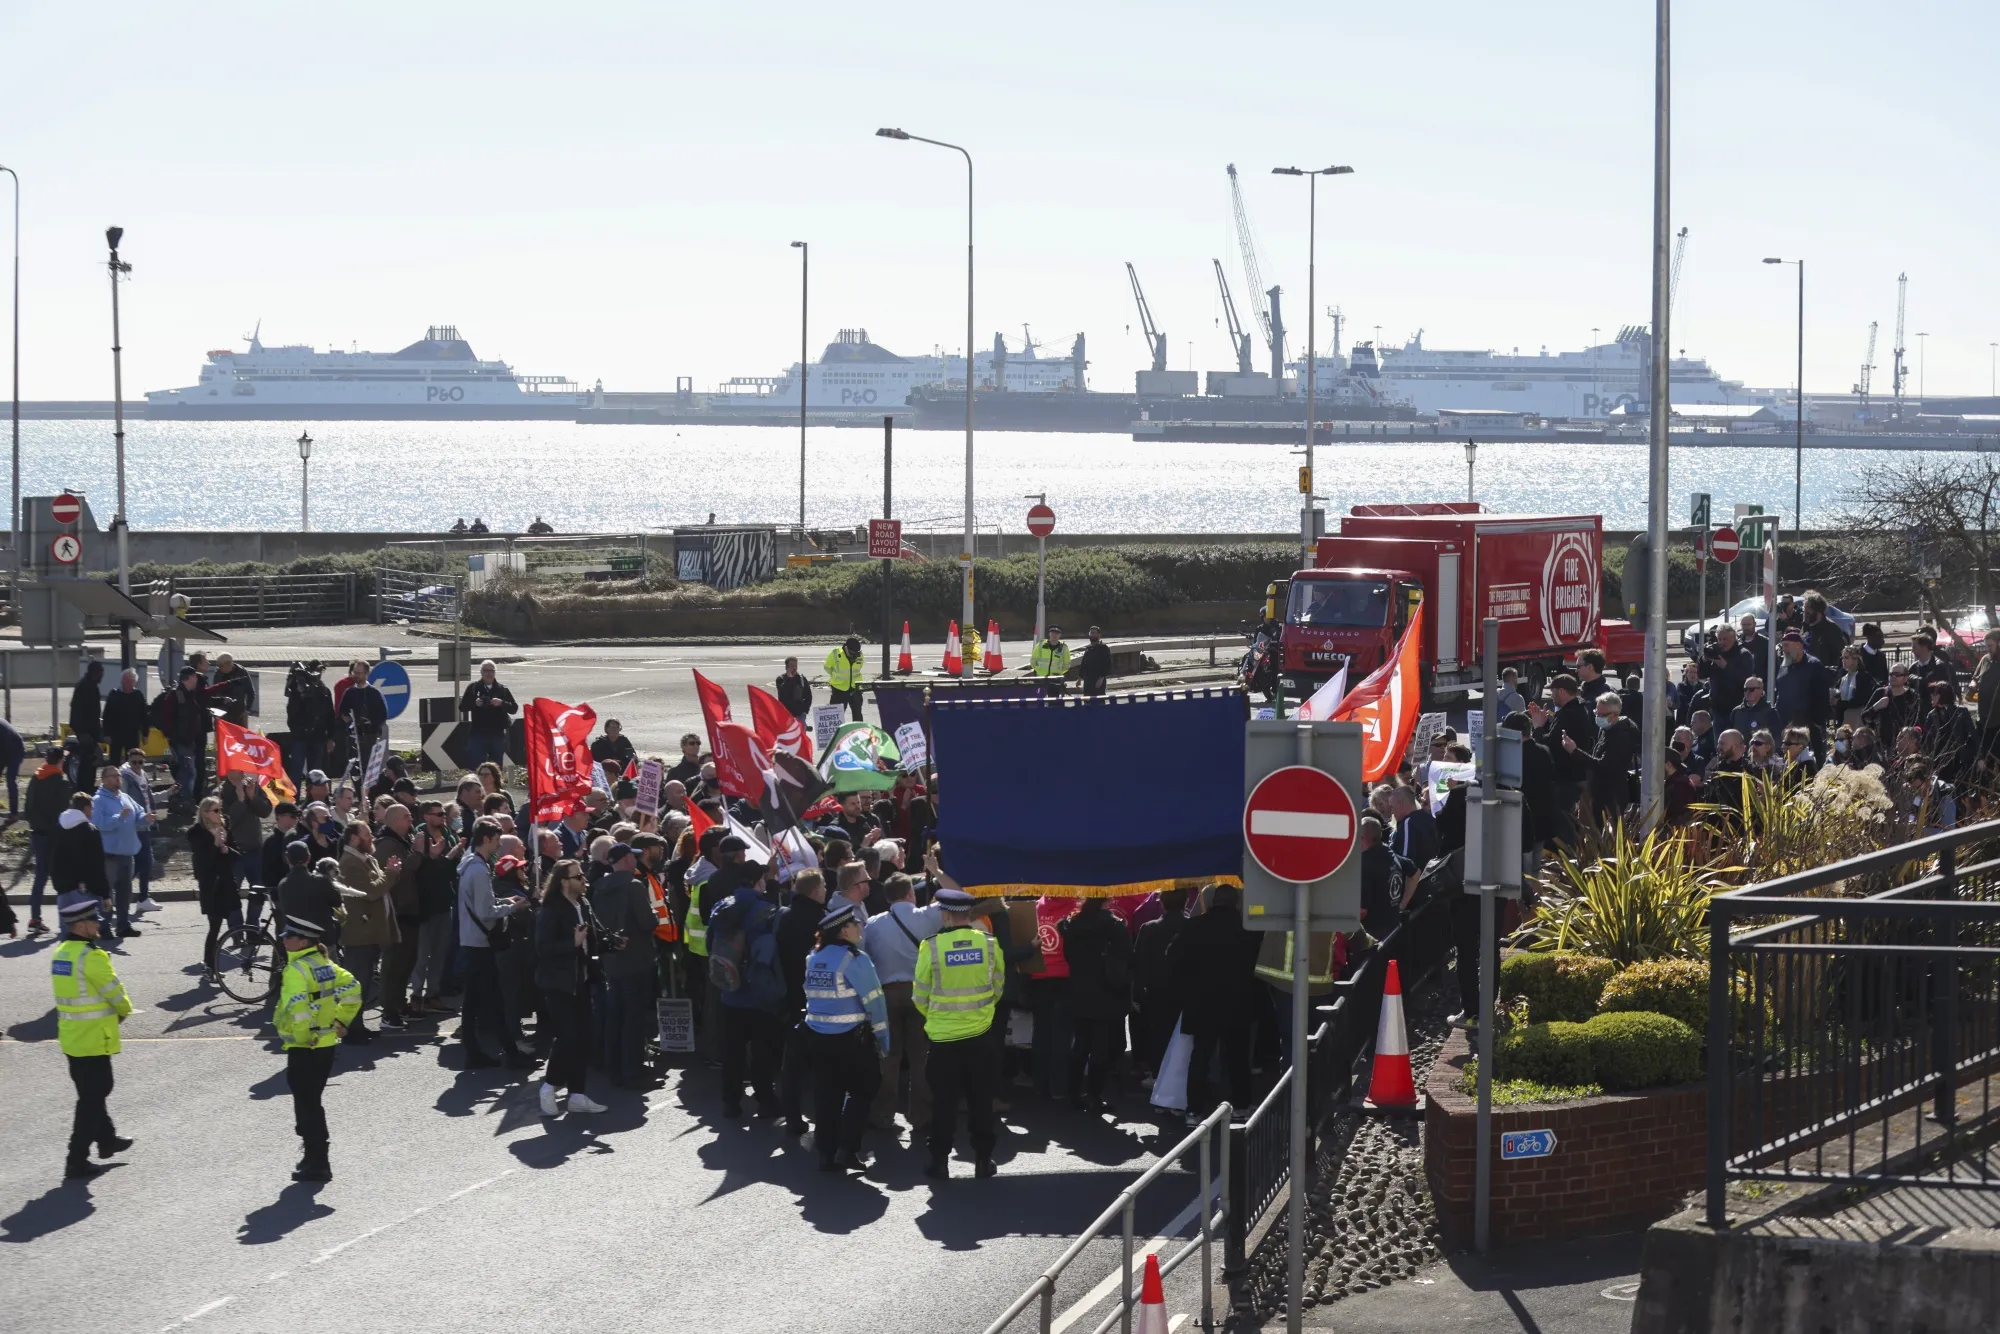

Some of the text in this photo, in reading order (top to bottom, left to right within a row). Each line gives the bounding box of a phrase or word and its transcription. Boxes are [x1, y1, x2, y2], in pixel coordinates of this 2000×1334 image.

[426, 386, 464, 402] P&O
[841, 388, 878, 405] P&O
[1564, 558, 1579, 582] FIRE
[1556, 584, 1587, 609] BRIGADES
[1560, 611, 1581, 635] UNION
[1312, 652, 1346, 660] IVECO
[910, 741, 925, 750] JOBS
[947, 952, 981, 963] POLICE
[665, 1033, 687, 1041] RESIST
[1508, 1142, 1512, 1150] 1
